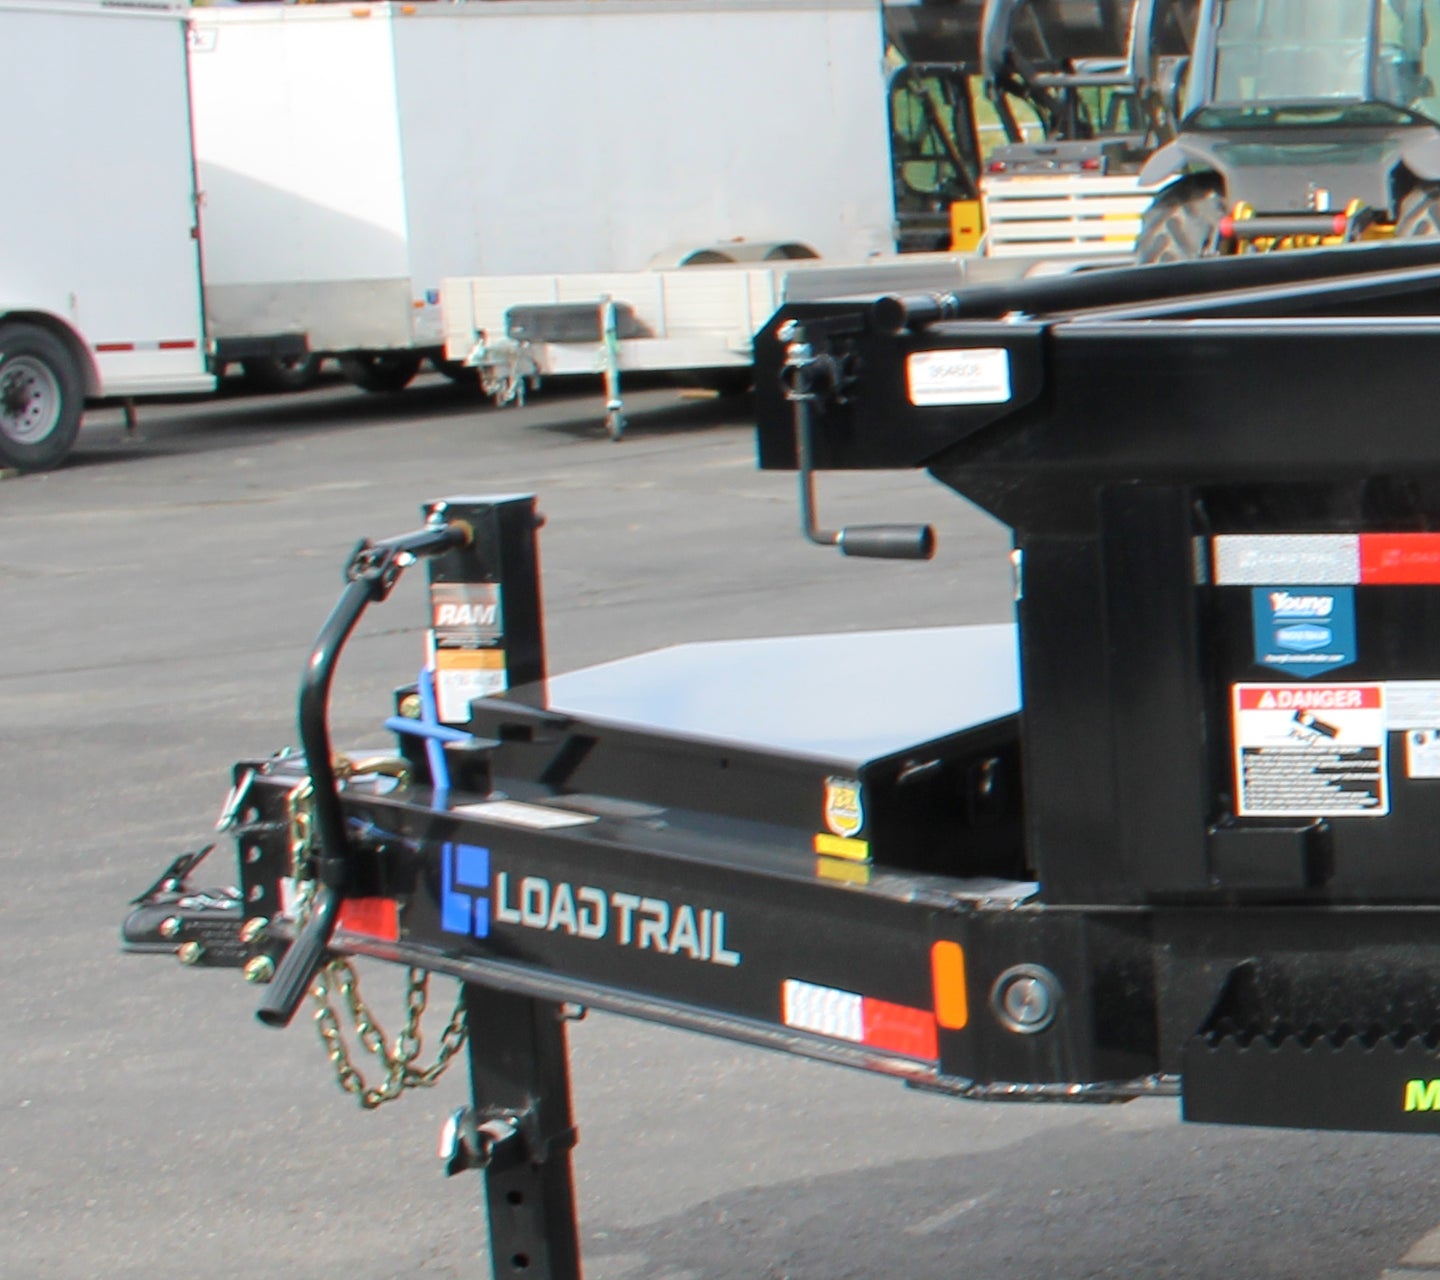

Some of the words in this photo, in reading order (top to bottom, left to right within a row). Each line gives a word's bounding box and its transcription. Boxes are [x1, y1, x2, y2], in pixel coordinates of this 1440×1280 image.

[1400, 552, 1440, 563] LOAD
[434, 603, 498, 626] RAM
[1268, 592, 1334, 616] Young
[1278, 690, 1362, 708] DANGER
[494, 871, 607, 939] LOAD
[609, 891, 741, 966] TRAIL
